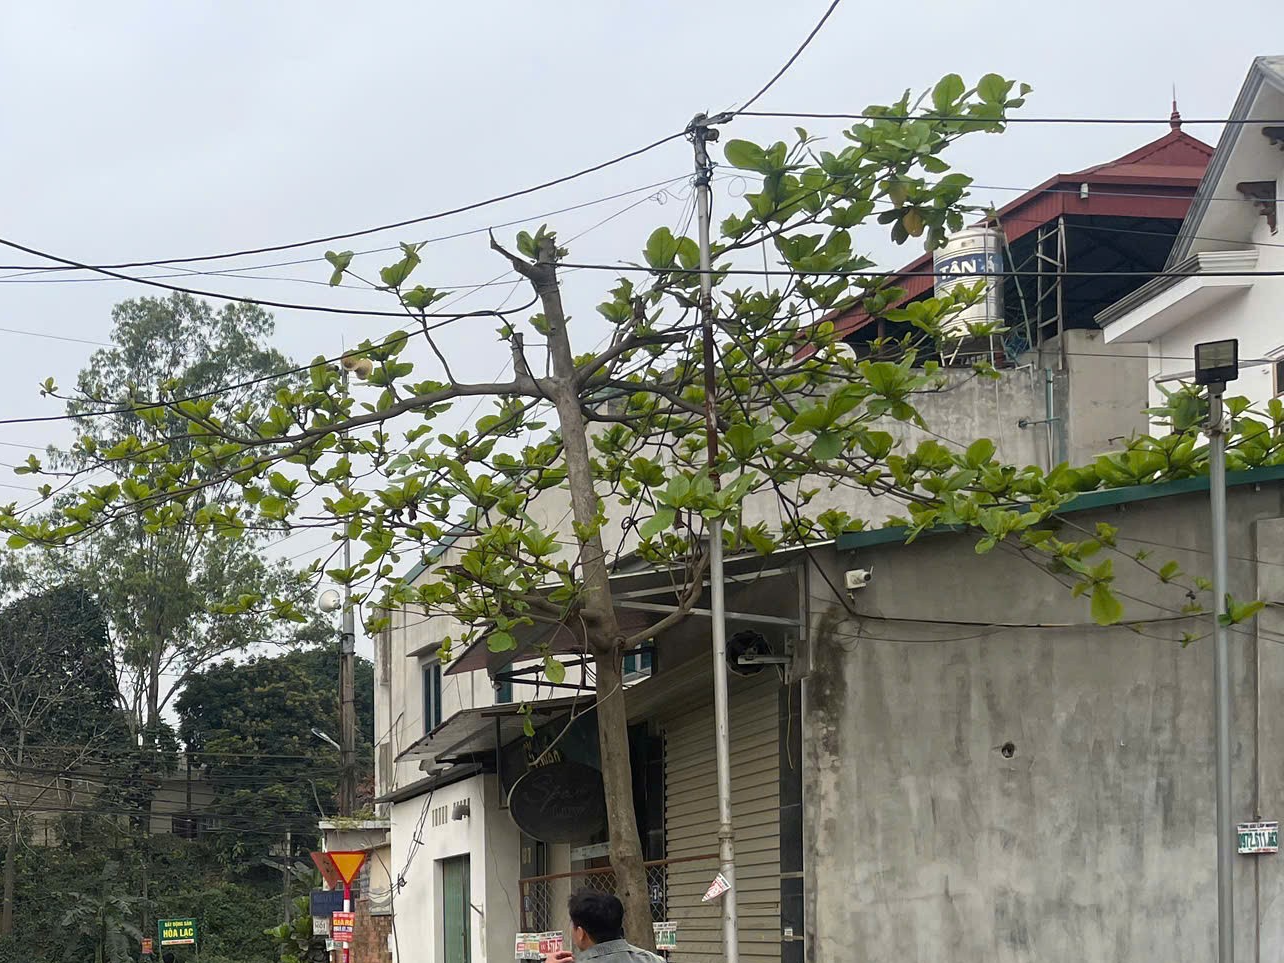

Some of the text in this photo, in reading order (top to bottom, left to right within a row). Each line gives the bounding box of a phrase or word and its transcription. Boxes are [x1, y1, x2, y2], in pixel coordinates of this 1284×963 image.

[939, 260, 976, 279] TÂN
[163, 928, 194, 938] HÒA LẠC
